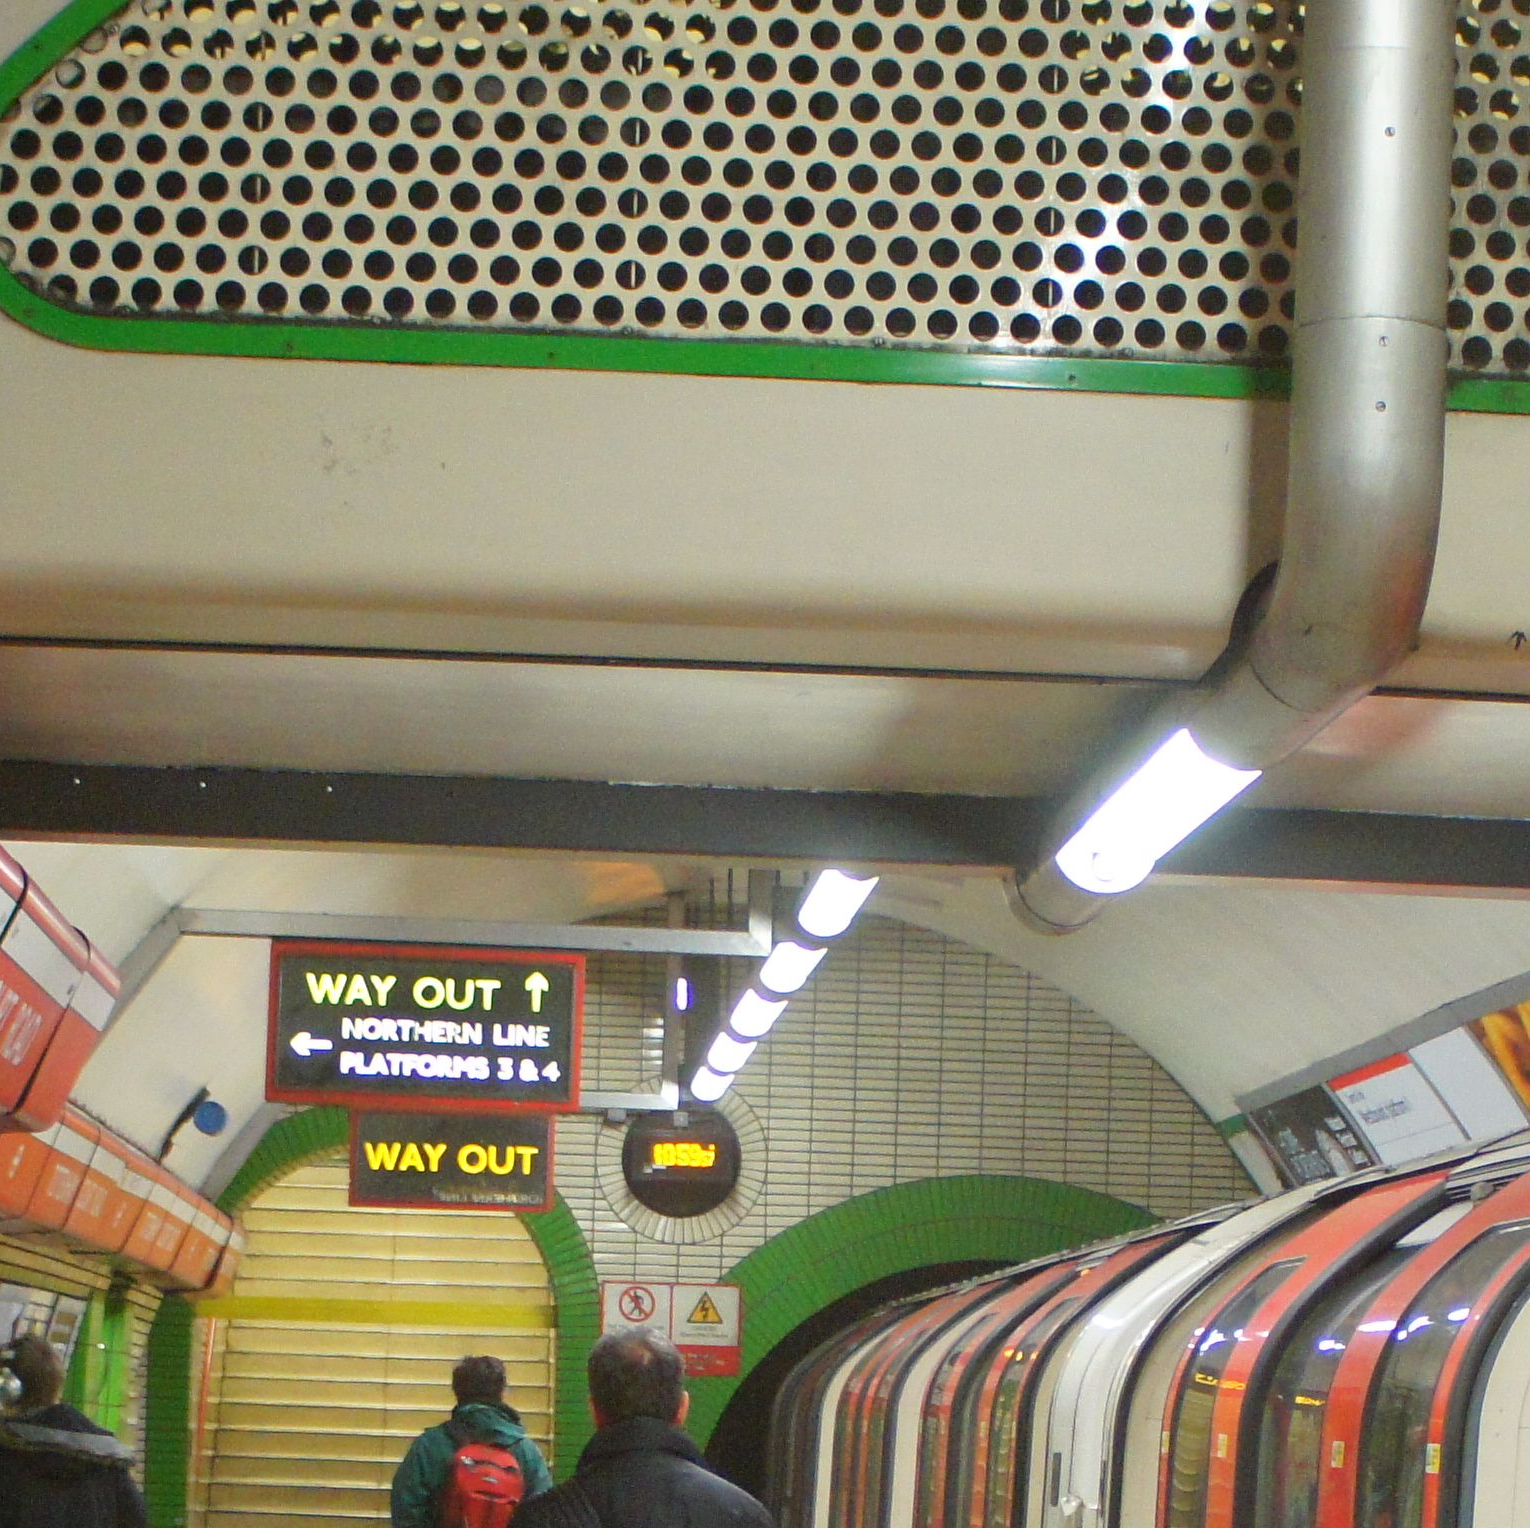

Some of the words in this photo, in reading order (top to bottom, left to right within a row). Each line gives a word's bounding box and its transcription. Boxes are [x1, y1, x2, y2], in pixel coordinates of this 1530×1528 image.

[306, 972, 397, 1007] WAY
[412, 976, 502, 1011] OUT
[341, 1016, 483, 1046] NORTHERN
[493, 1023, 551, 1048] LINE
[339, 1051, 491, 1081] PLATFORMS
[497, 1056, 515, 1081] 3
[519, 1058, 540, 1082] &
[542, 1060, 561, 1083] 4
[364, 1141, 448, 1173] WAY
[456, 1142, 540, 1176] OUT
